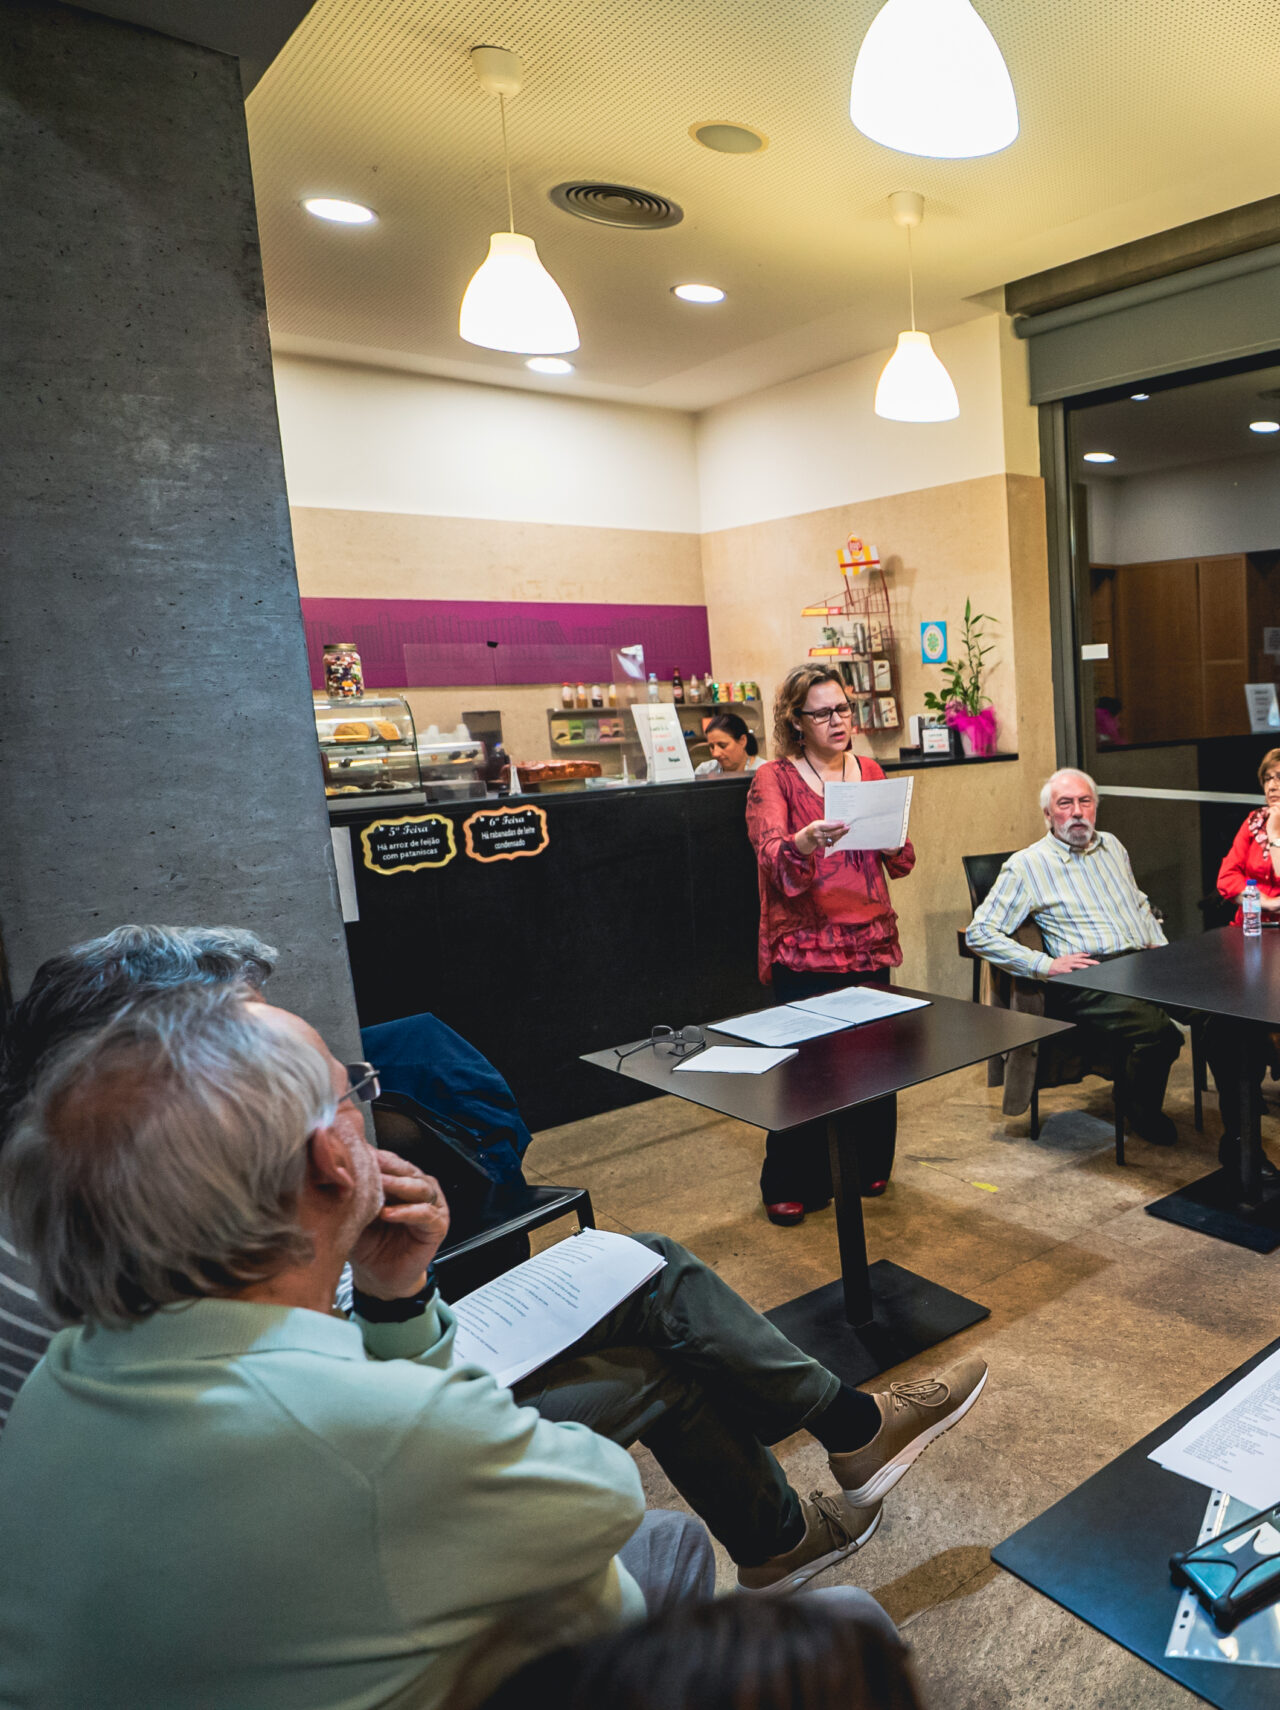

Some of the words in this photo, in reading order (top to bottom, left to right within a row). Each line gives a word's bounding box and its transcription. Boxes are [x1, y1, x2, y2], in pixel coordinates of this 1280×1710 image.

[502, 815, 525, 825] Feira
[402, 825, 428, 835] Feira
[377, 843, 388, 852] Há
[389, 841, 408, 850] arroz
[410, 839, 419, 848] de
[420, 836, 440, 847] feijão
[494, 838, 526, 850] condensado
[382, 852, 399, 861] com
[400, 848, 438, 860] pataniscas
